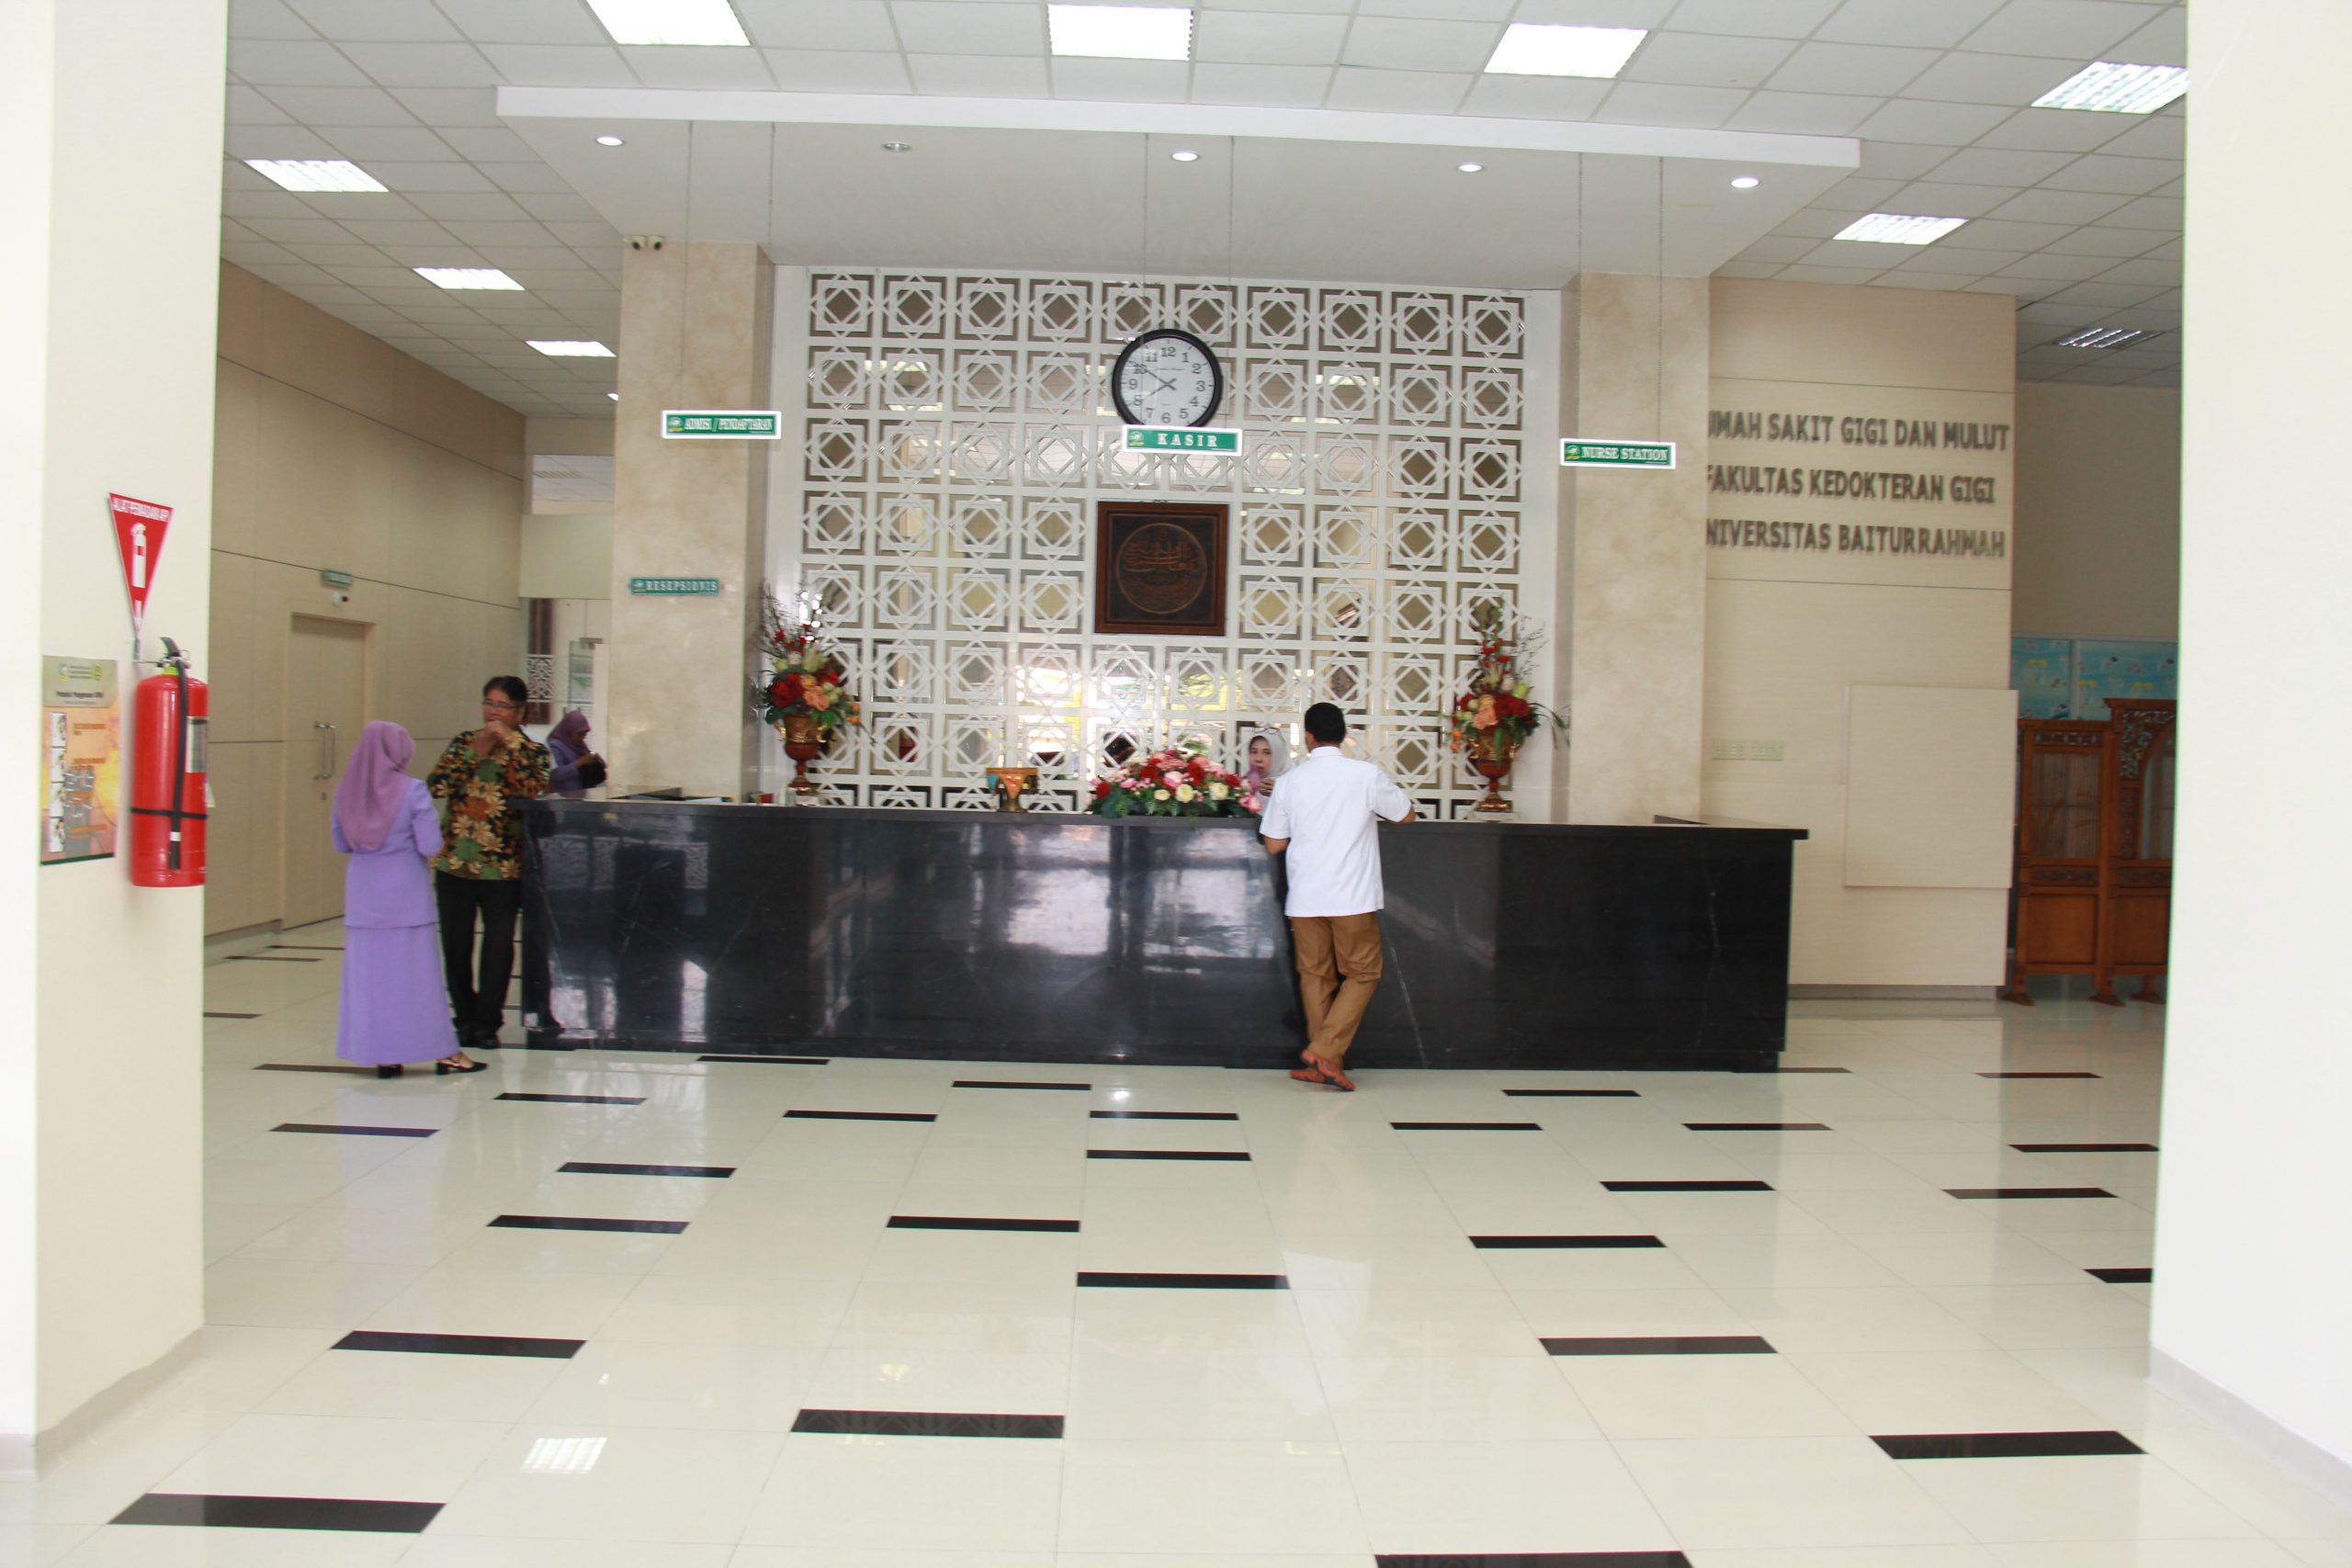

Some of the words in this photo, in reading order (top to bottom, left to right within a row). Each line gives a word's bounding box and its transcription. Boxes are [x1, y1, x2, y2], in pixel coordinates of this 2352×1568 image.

[1160, 346, 1176, 357] 12
[1146, 353, 1158, 362] 11
[1182, 353, 1189, 363] 1
[1192, 363, 1201, 374] 2
[1128, 378, 1137, 389] 9
[1196, 380, 1205, 391] 3
[1134, 395, 1143, 406] 8
[1190, 396, 1199, 407] 4
[1146, 408, 1154, 418] 7
[1161, 412, 1171, 423] 6
[1180, 408, 1188, 419] 5
[1708, 410, 1762, 440] MAH
[1768, 412, 1834, 442] SAKIT
[1841, 416, 1888, 446] GIGI
[1894, 419, 1937, 447] DAN
[1943, 422, 2010, 451] MULUT
[1157, 433, 1218, 447] KASIR
[1581, 446, 1619, 459] NURSE
[1621, 447, 1668, 461] STATION
[1809, 468, 1944, 502] KEDOKTERAN
[1951, 475, 1996, 503] GIGI
[1706, 518, 1832, 550] NIVERSITAS
[1838, 524, 2006, 558] BAITURRAHMAH
